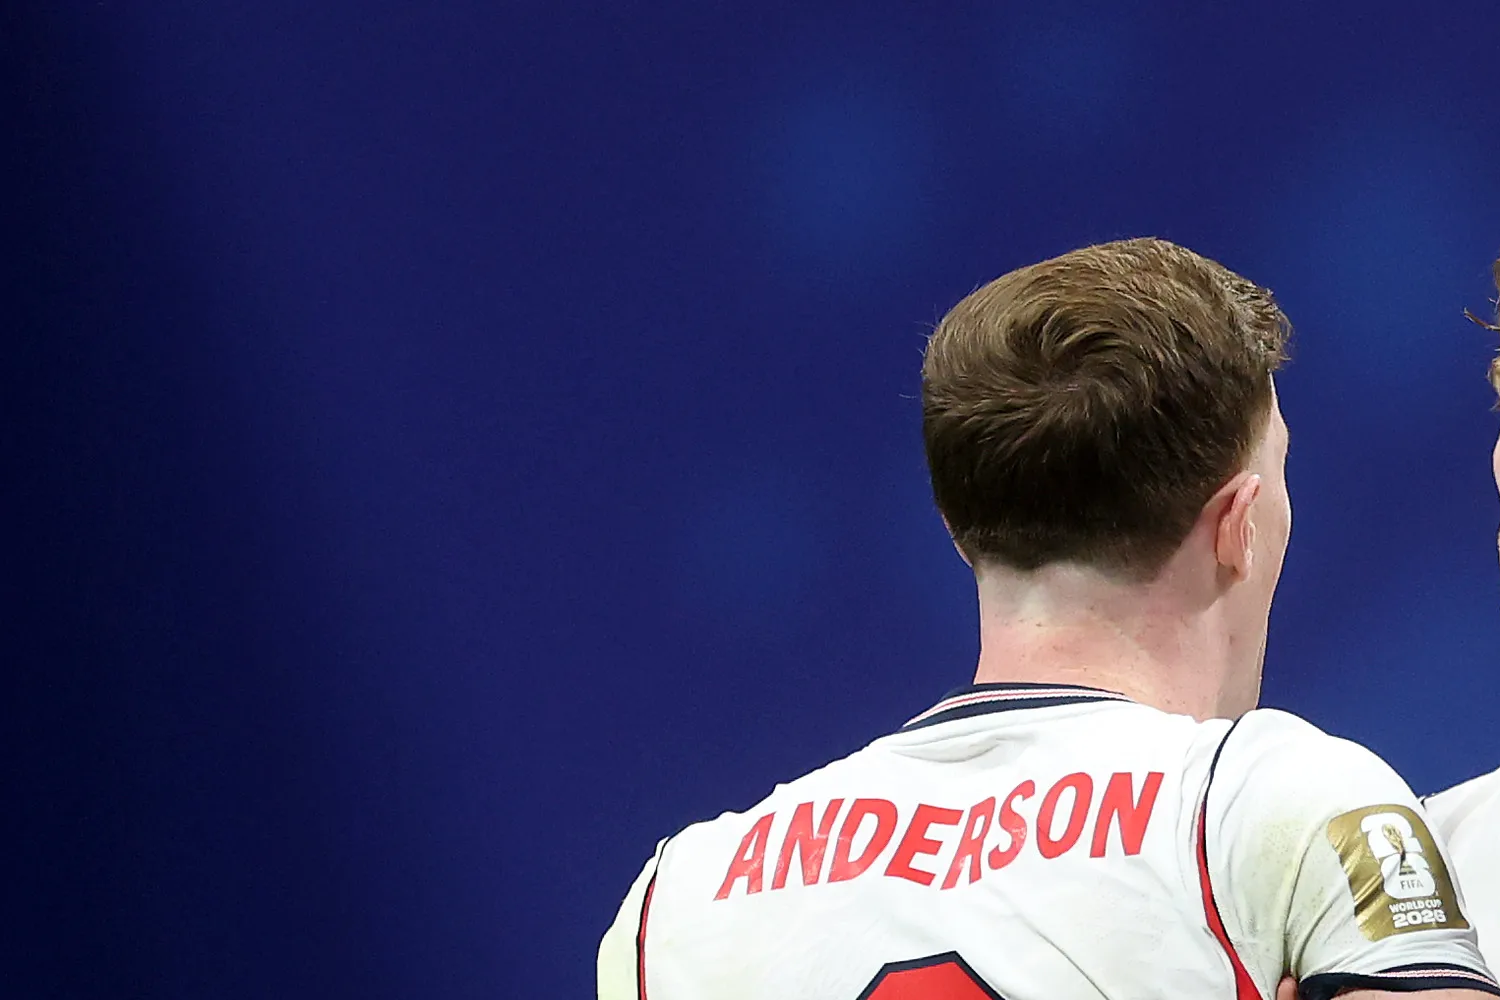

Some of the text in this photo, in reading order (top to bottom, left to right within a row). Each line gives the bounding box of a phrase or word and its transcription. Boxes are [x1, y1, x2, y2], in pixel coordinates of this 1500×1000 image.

[713, 771, 1164, 901] ANDERSON
[1400, 880, 1424, 890] FIFA
[1389, 900, 1425, 913] WORLD
[1393, 909, 1447, 928] 2026
